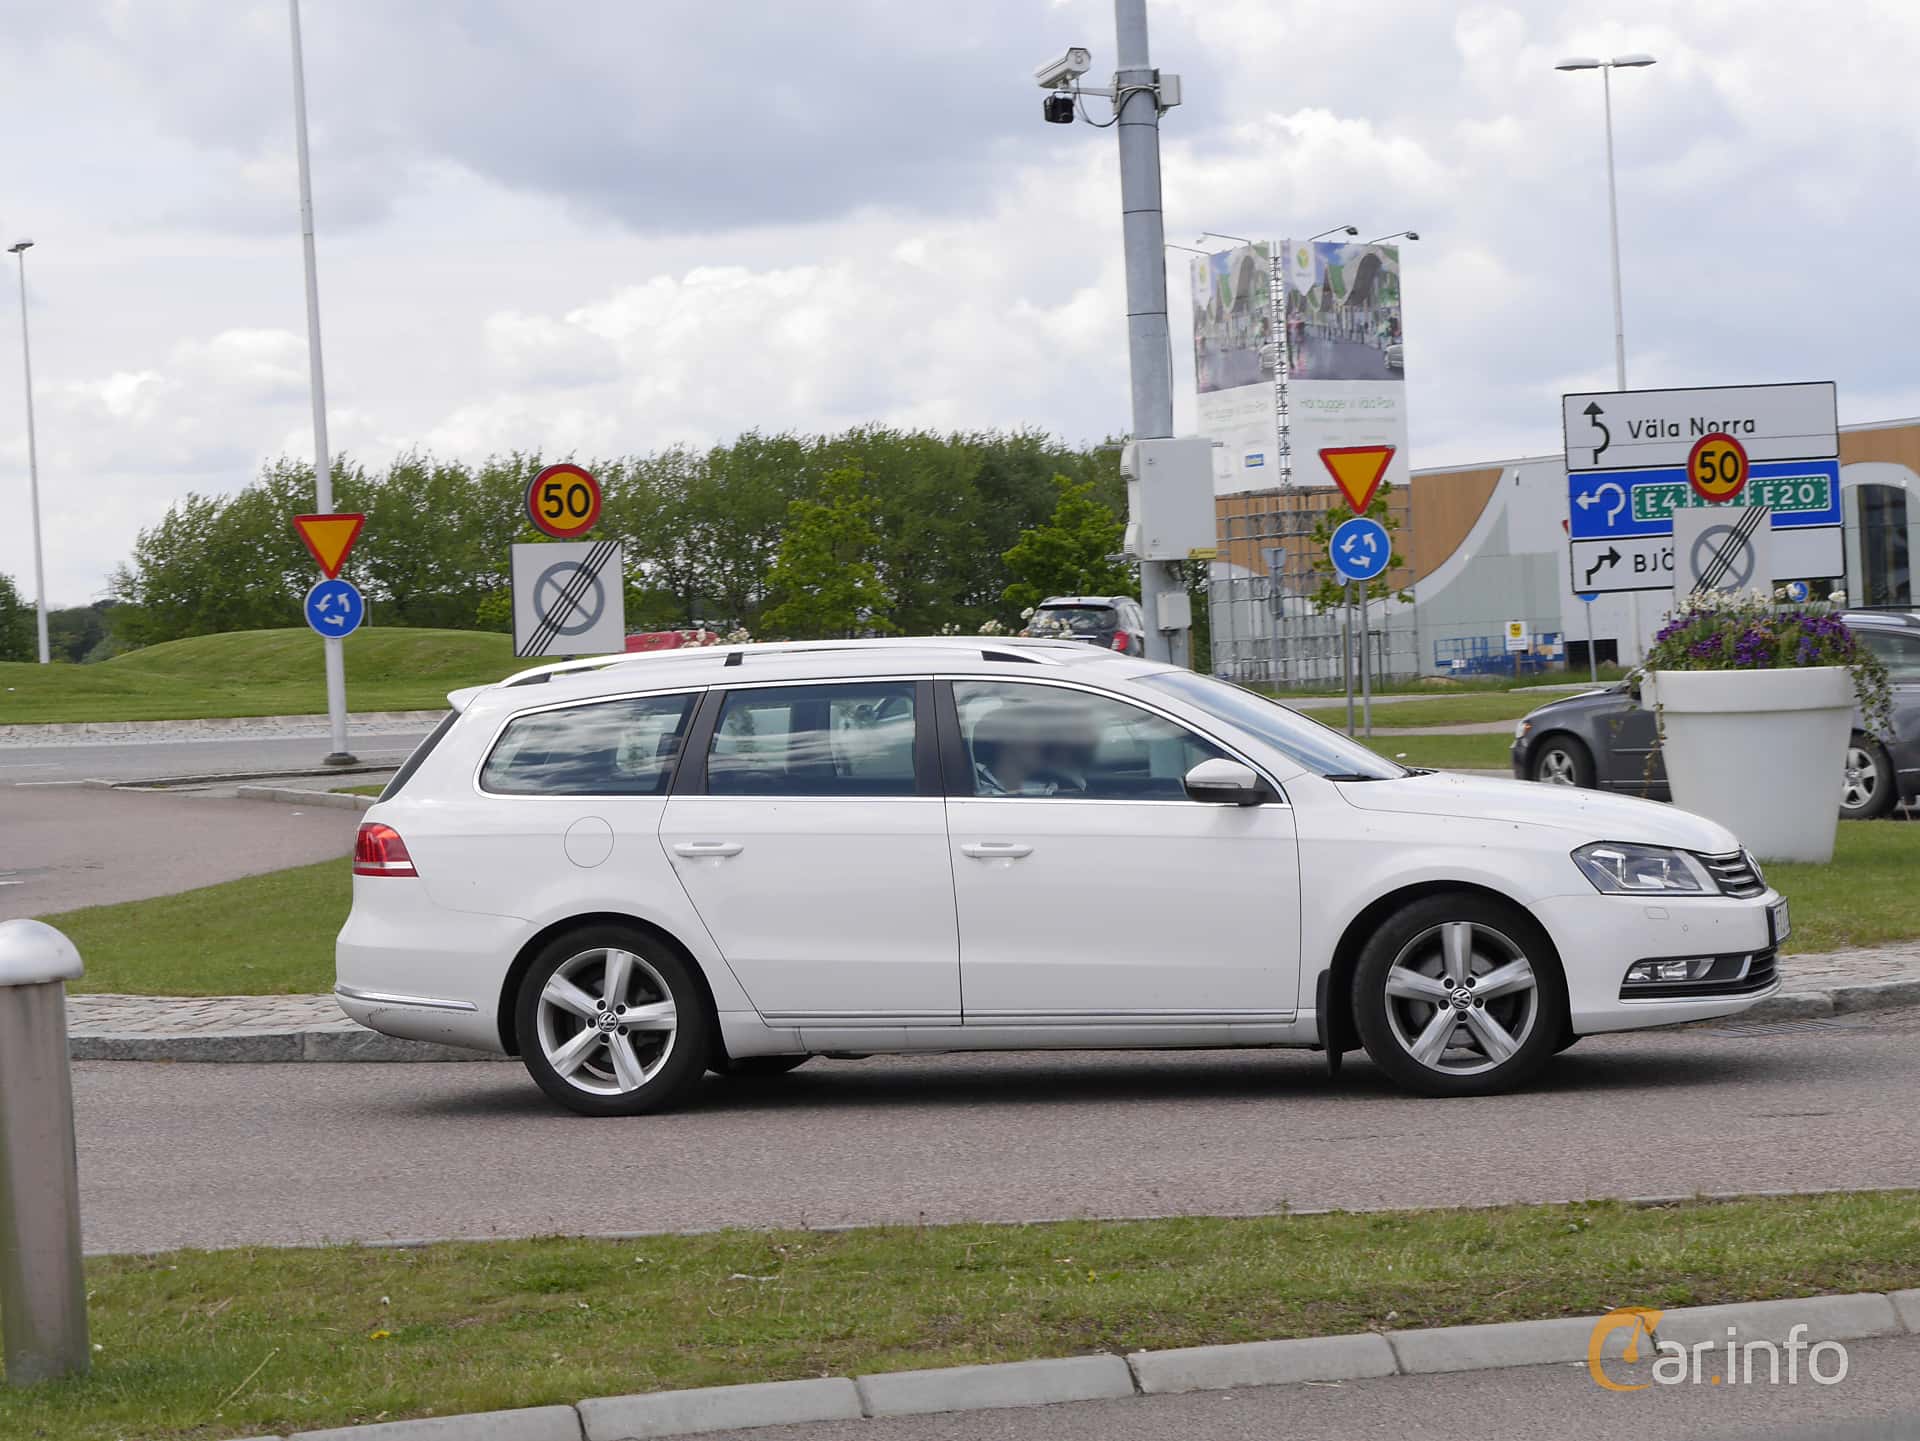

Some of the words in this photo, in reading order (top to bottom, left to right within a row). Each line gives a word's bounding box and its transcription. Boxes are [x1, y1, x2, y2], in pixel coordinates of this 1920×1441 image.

[1627, 419, 1681, 439] Väla
[1690, 416, 1756, 436] Norra
[1700, 450, 1739, 484] 50
[543, 483, 591, 518] 50
[1645, 491, 1678, 513] E4
[1763, 484, 1815, 506] E20
[1634, 547, 1674, 573] BJÖ
